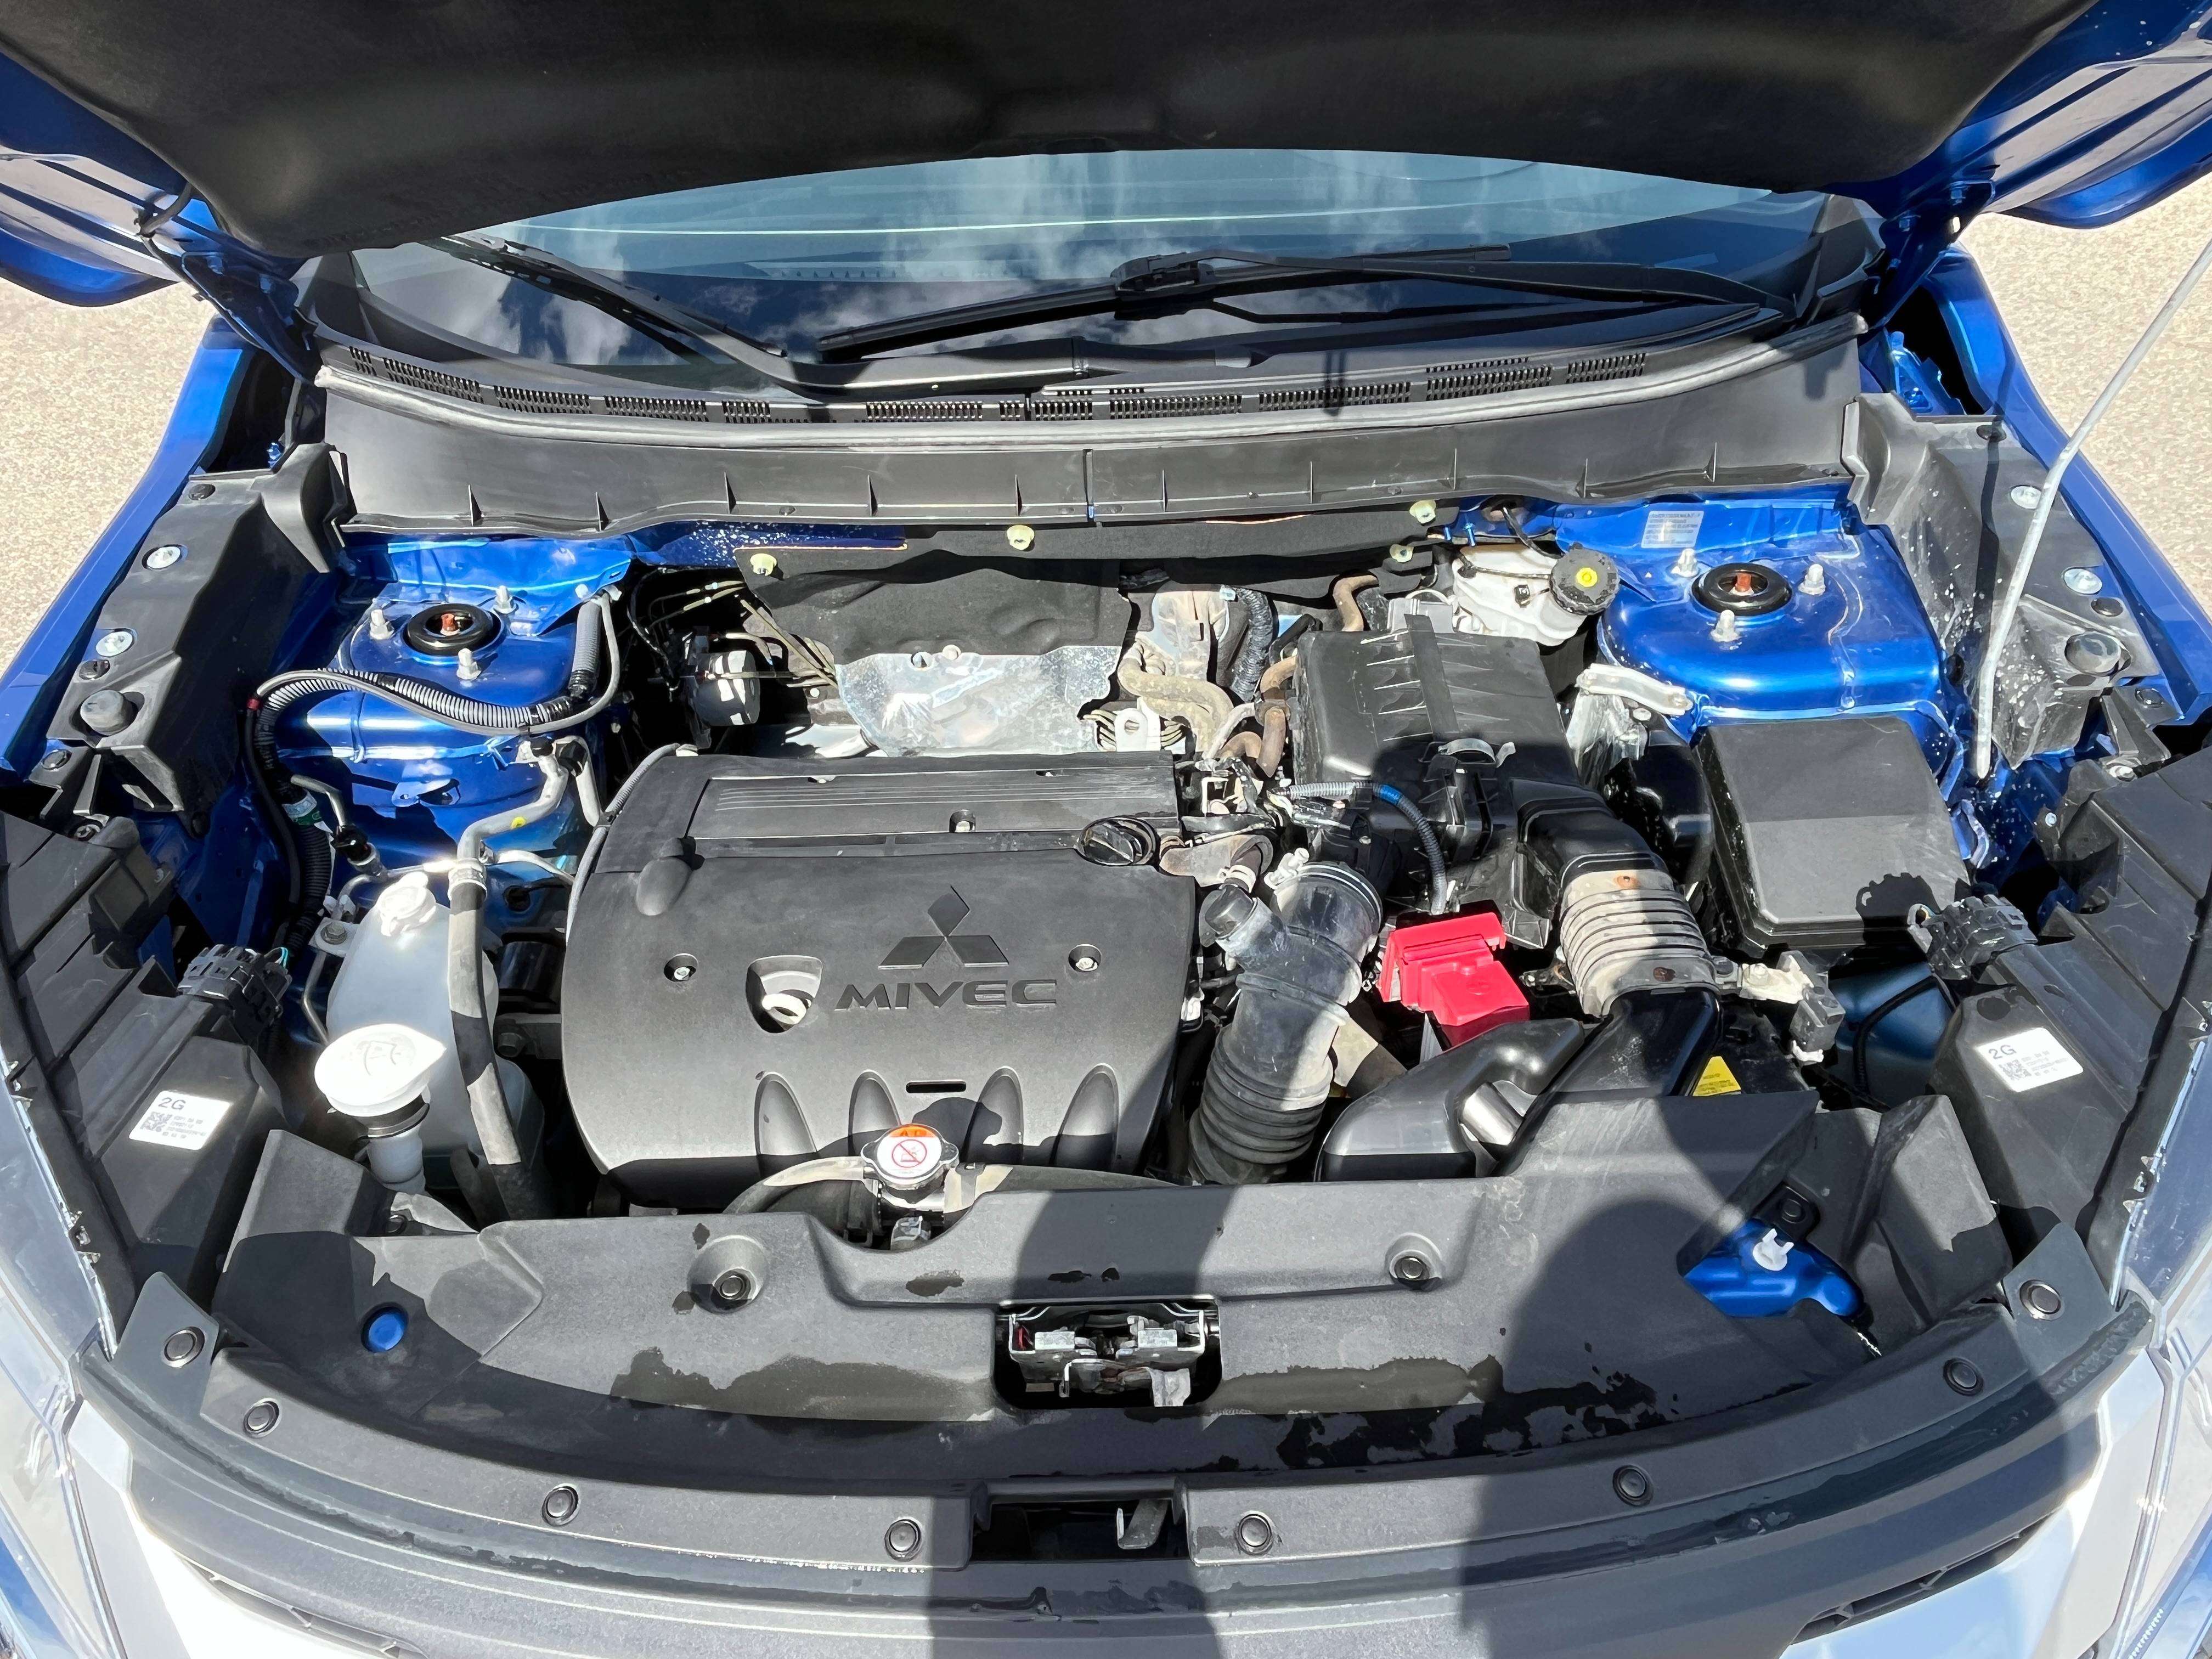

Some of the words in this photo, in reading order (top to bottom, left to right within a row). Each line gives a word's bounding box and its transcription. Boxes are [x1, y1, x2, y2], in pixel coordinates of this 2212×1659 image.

[834, 979, 1057, 1010] MIVEC
[1988, 1045, 2017, 1060] 2G
[158, 1097, 187, 1111] 2G
